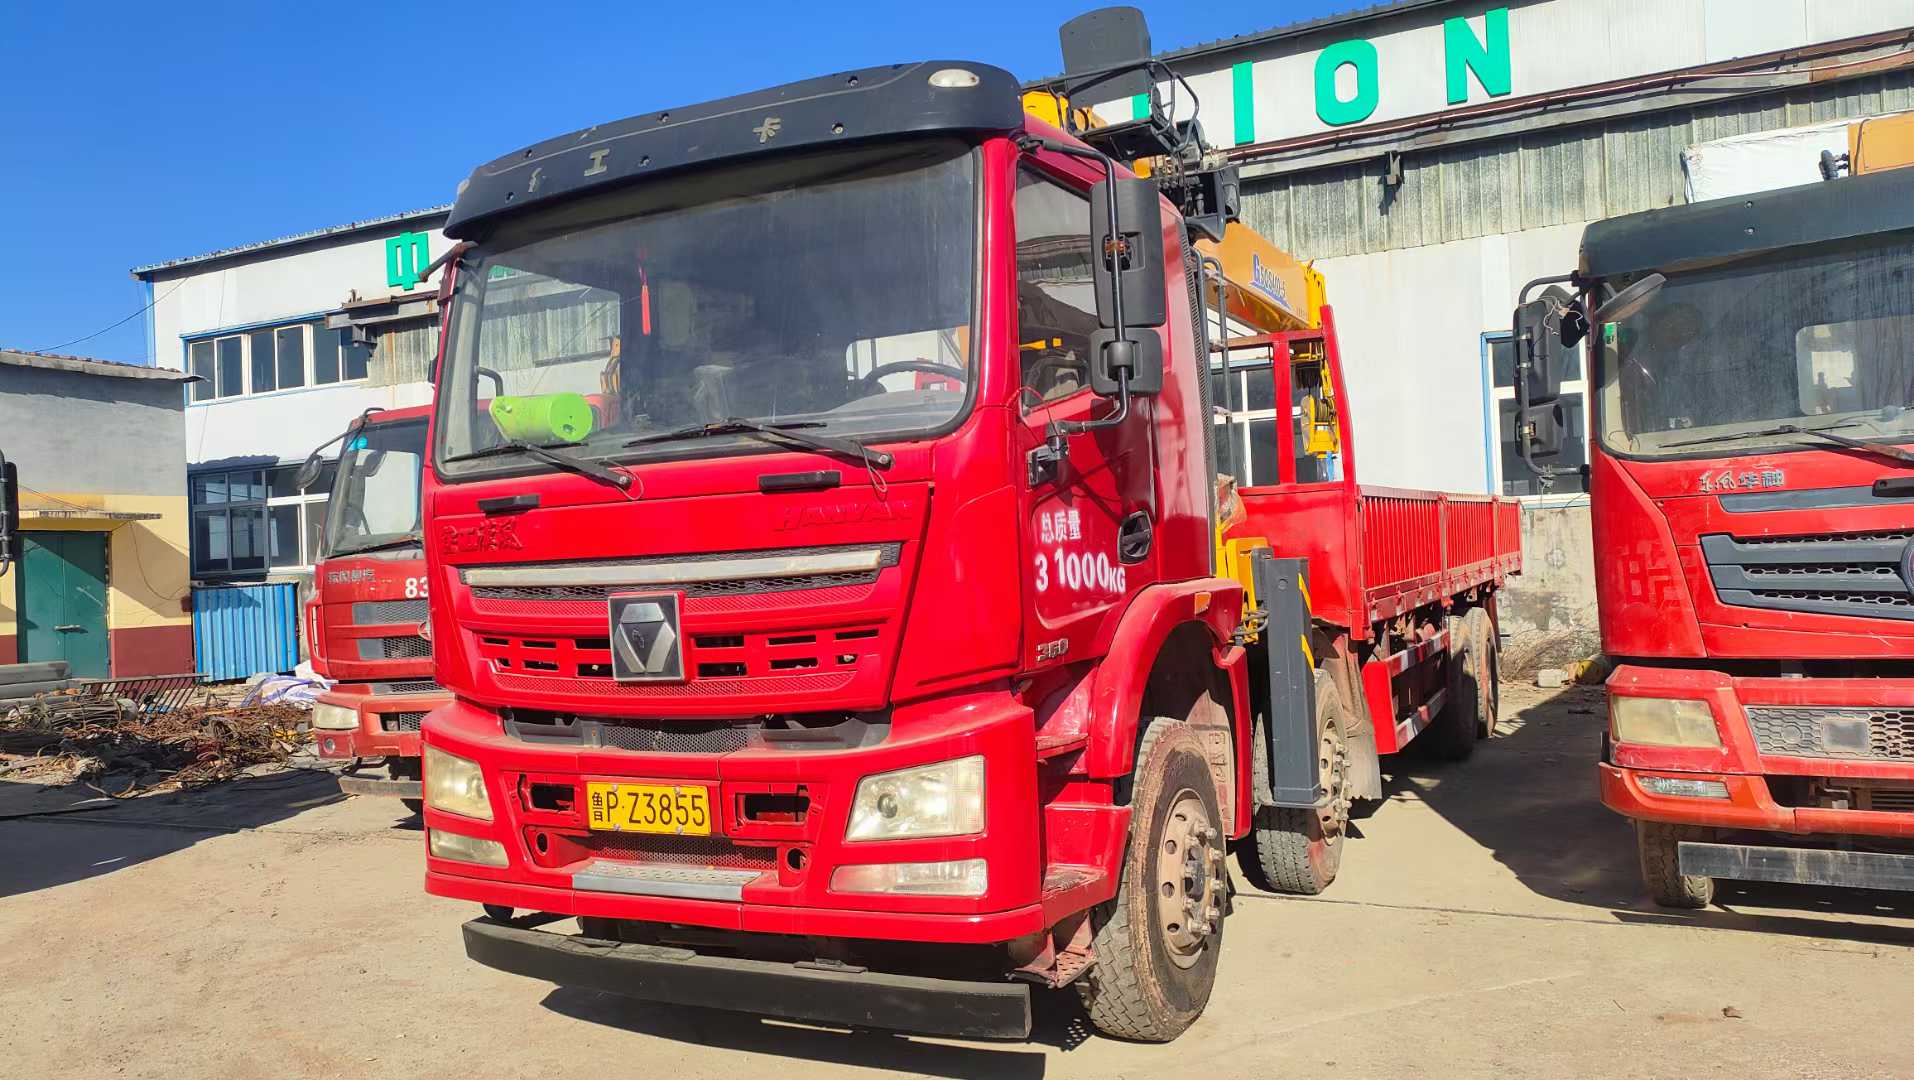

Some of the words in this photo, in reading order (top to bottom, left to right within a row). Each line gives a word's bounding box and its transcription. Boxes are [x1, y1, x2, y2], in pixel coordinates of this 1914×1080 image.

[386, 231, 430, 291] 中
[1040, 511, 1081, 544] 总质量
[405, 576, 429, 599] 83
